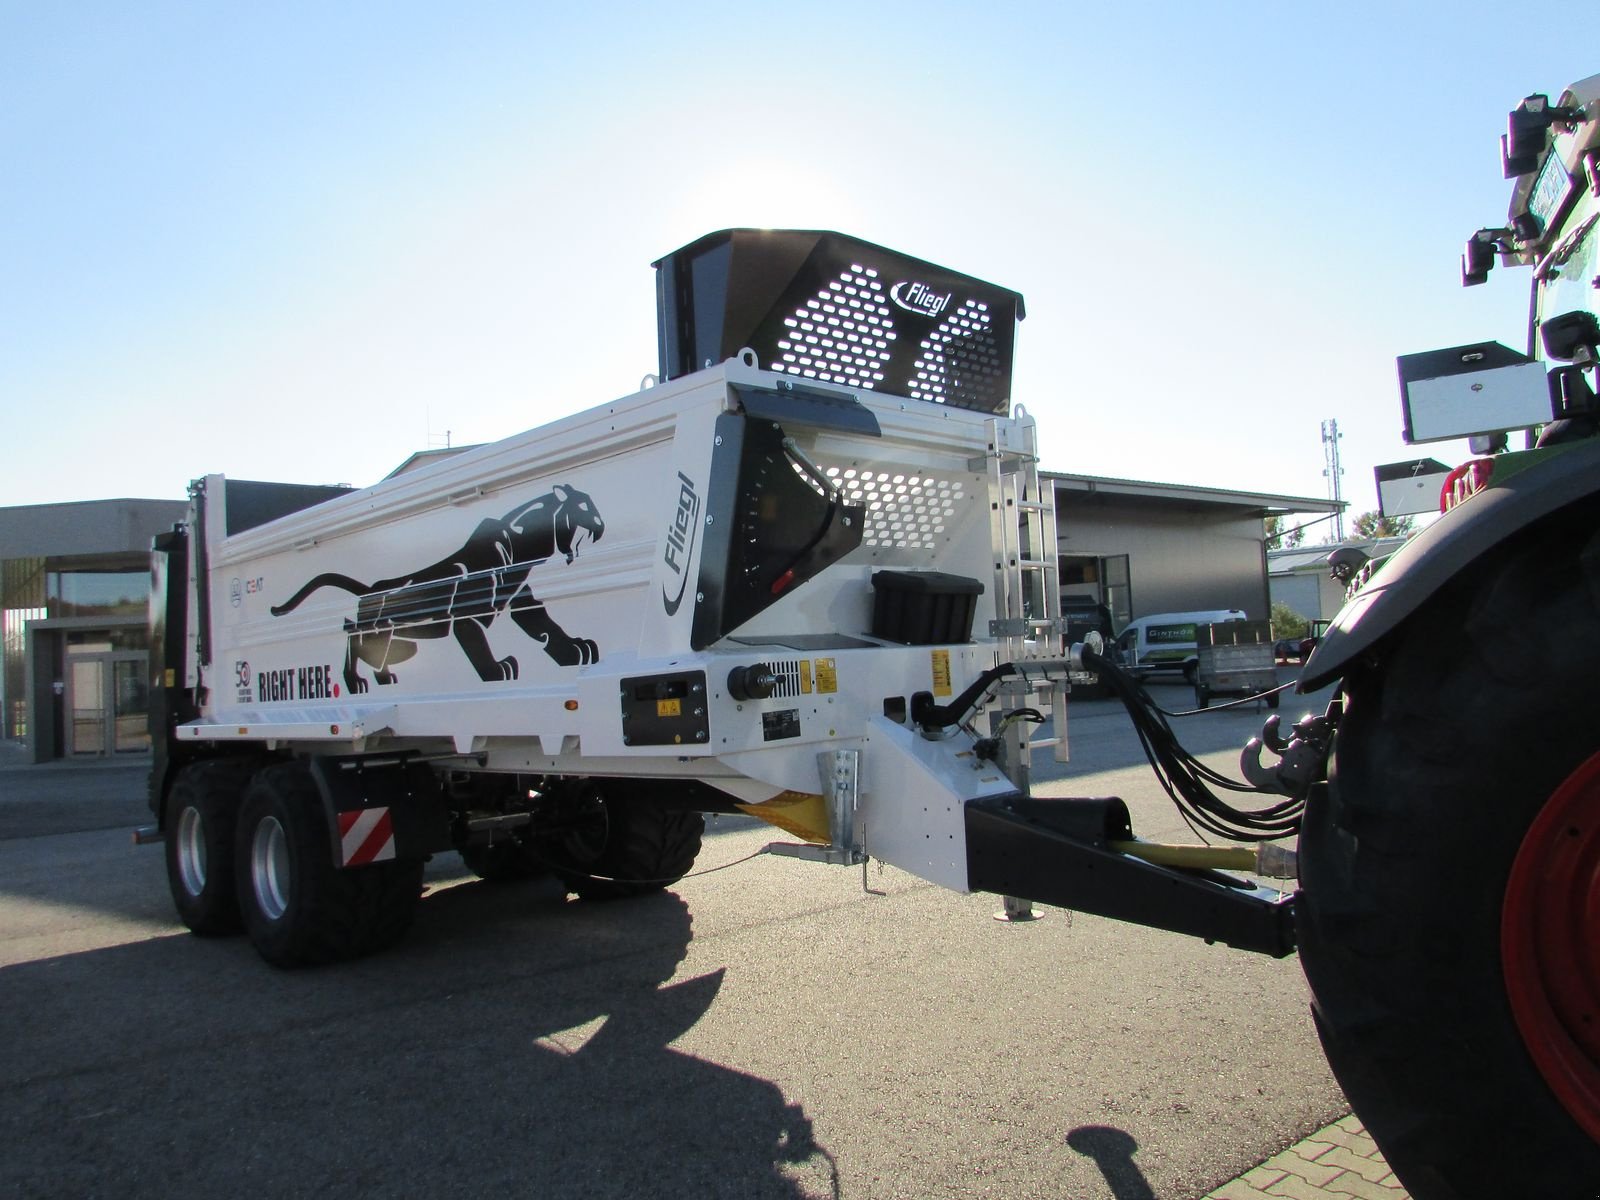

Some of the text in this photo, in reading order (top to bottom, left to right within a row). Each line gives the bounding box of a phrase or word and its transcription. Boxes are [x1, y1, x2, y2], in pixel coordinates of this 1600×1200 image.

[905, 282, 952, 314] Fliegl
[664, 471, 697, 575] Fliegl
[258, 669, 295, 702] RIGHT
